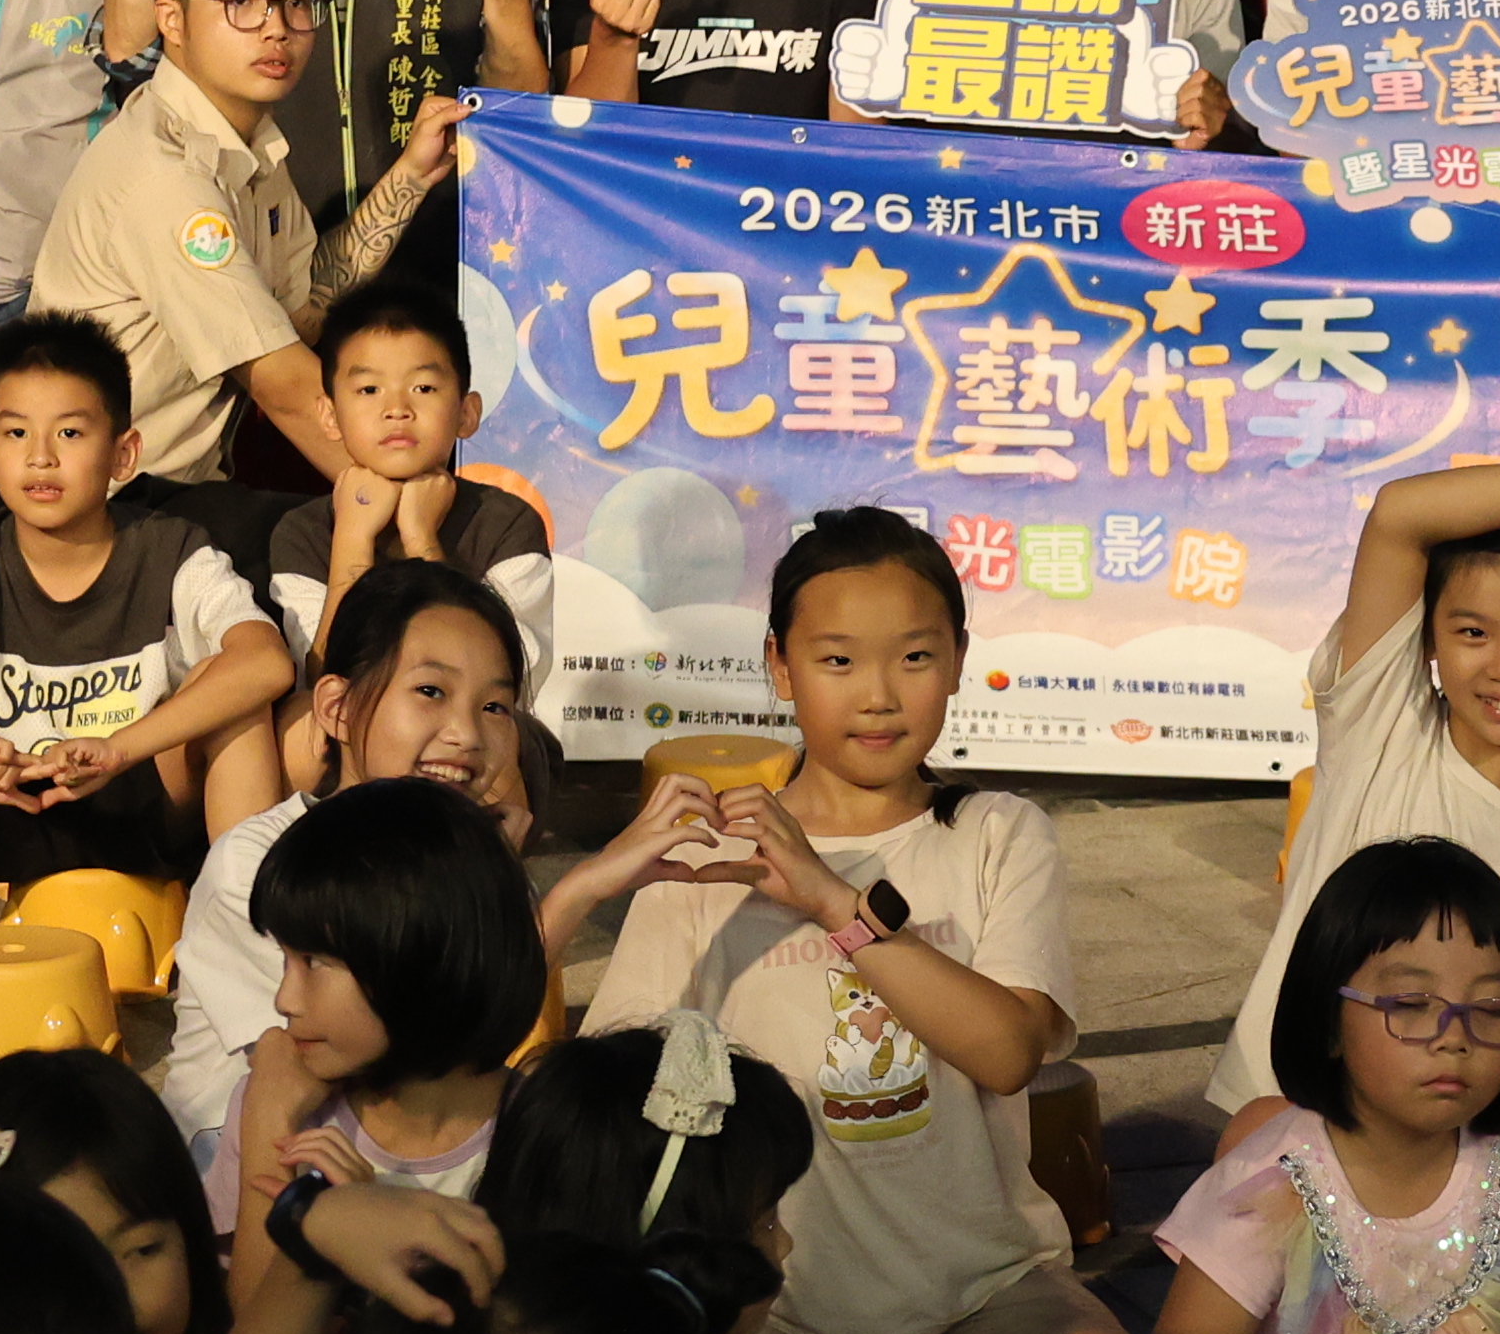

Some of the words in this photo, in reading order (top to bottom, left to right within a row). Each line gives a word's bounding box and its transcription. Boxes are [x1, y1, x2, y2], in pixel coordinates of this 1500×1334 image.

[419, 65, 443, 96] 全
[900, 17, 1117, 124] 最讚
[388, 55, 417, 148] 陳哲郎
[738, 185, 1101, 246] 2026新北市
[1146, 202, 1281, 255] 新莊
[587, 269, 1391, 481] 兒童藝術季
[791, 506, 1243, 604] 光電影院
[1017, 674, 1096, 692] 台灣大寬頻
[1112, 680, 1246, 698] 永佳樂數位有線電視
[76, 712, 100, 727] NEW
[102, 707, 137, 725] JERSEY
[1159, 725, 1310, 744] 新北市新莊區裕民國小
